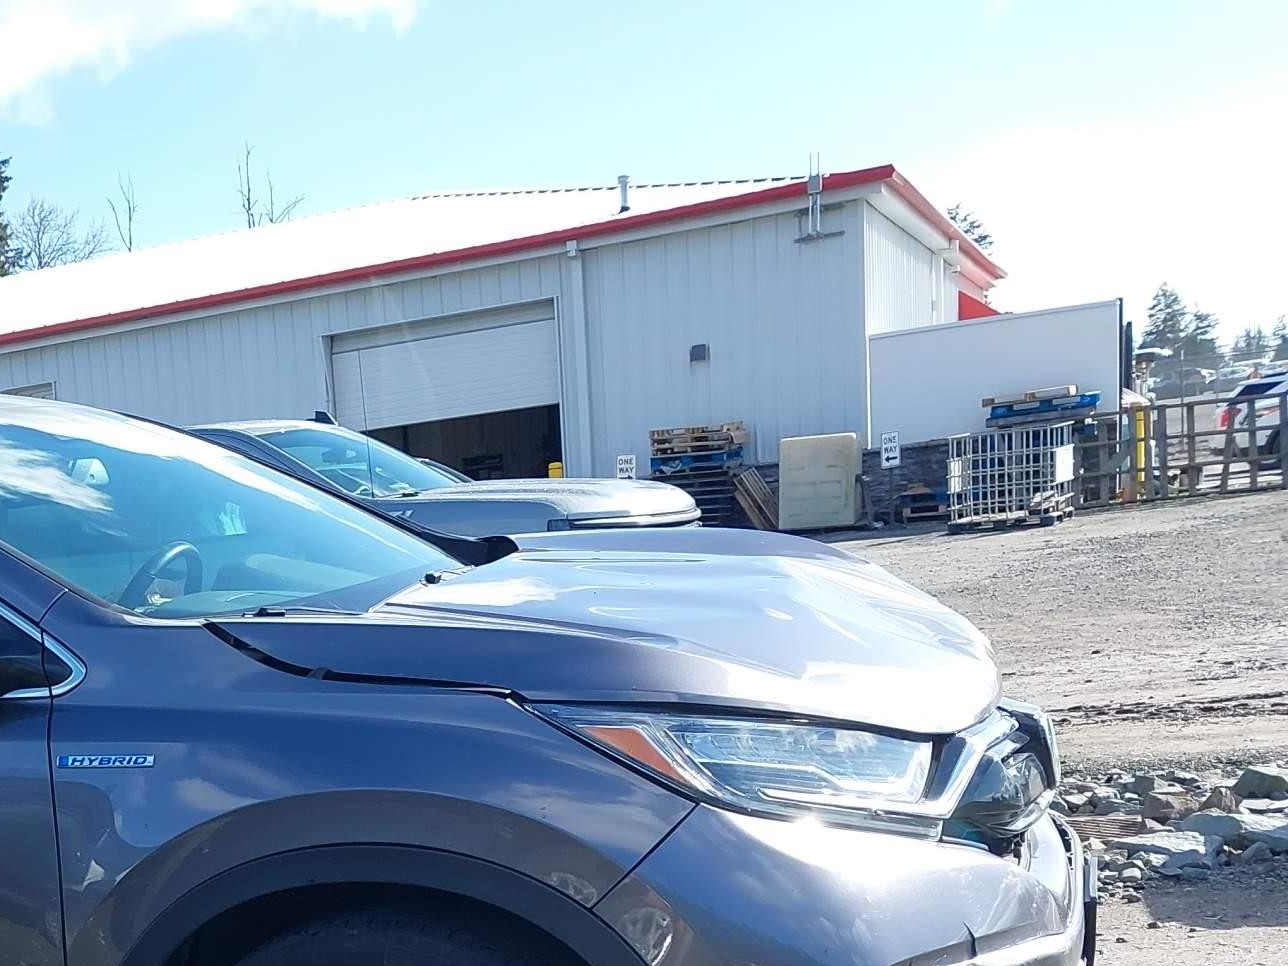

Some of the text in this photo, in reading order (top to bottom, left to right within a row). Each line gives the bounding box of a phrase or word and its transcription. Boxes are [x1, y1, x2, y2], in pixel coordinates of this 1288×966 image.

[884, 436, 897, 445] ONE
[884, 445, 898, 454] WAY
[618, 458, 634, 466] ONE
[618, 466, 634, 474] WAY
[70, 756, 148, 766] HYBRID
